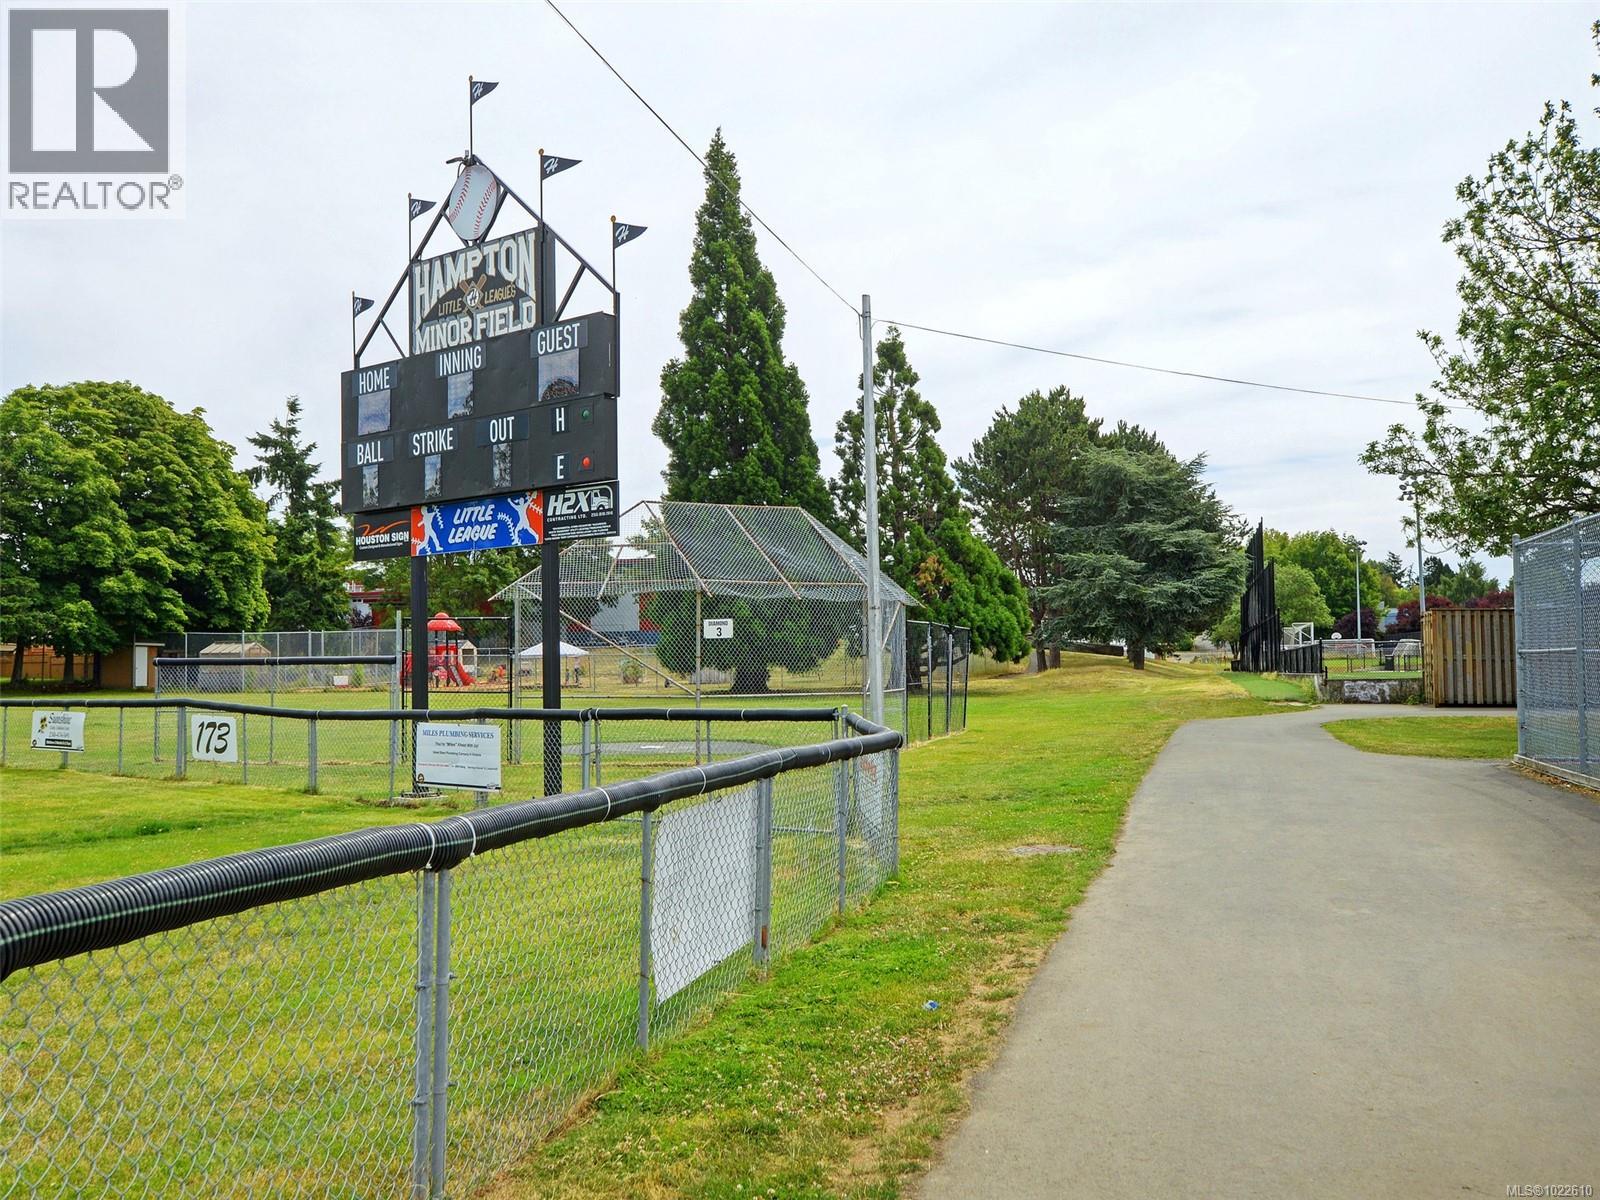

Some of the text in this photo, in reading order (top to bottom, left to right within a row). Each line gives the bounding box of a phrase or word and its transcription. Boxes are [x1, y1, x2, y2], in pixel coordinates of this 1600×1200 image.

[413, 230, 537, 328] HAMPTON
[438, 297, 463, 316] LITTLE
[413, 298, 537, 356] MINOR FIELD
[537, 323, 580, 355] GUEST
[439, 346, 482, 375] INNING
[358, 367, 390, 394] HOME
[489, 416, 515, 443] OUT
[555, 407, 565, 432] H
[357, 441, 384, 464] BALL
[412, 428, 454, 456] STRIKE
[556, 455, 565, 480] E
[453, 504, 493, 525] LITTLE
[547, 491, 591, 516] H2X
[547, 514, 577, 522] CONTRACTING
[355, 533, 390, 546] HOUSTON
[391, 531, 410, 542] SIGN
[448, 523, 499, 544] LEAGUE
[716, 627, 722, 637] 3
[195, 721, 231, 754] 173
[439, 730, 468, 738] PLUMBING
[468, 731, 494, 739] SERVICES
